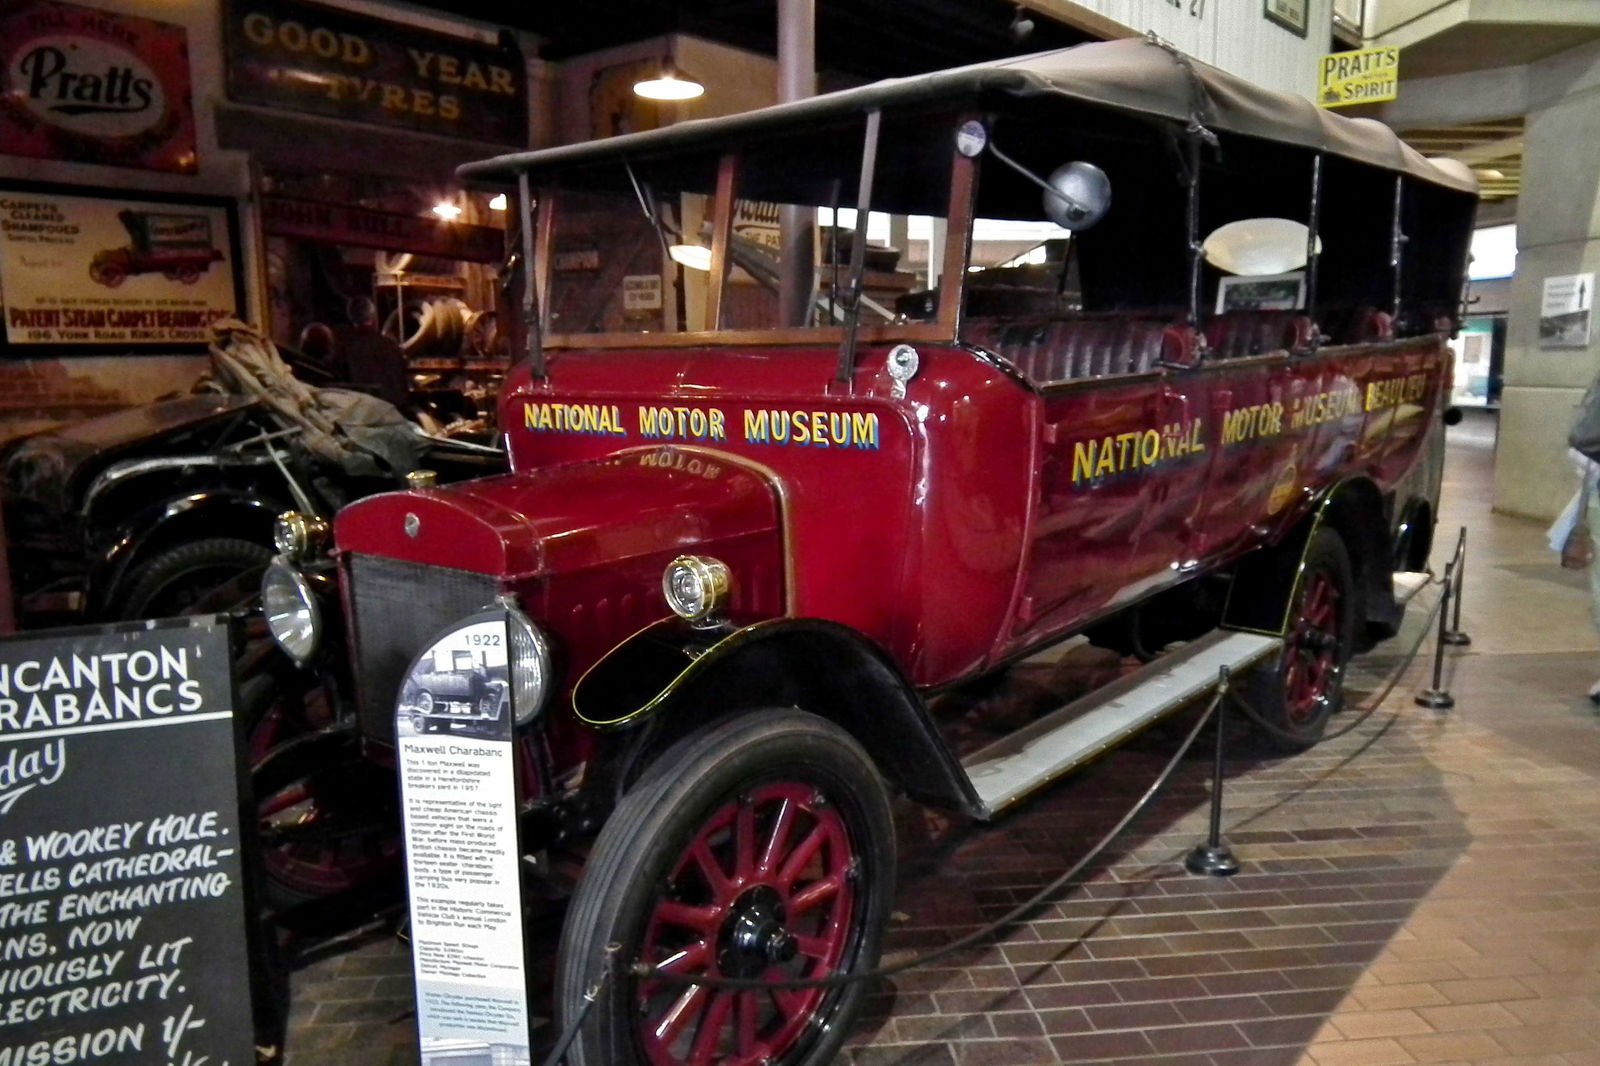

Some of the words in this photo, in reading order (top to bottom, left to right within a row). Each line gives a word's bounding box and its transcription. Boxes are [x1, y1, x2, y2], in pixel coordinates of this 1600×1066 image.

[243, 12, 371, 66] GOOD
[407, 46, 516, 97] YEAR
[1324, 47, 1397, 86] PRATTS
[20, 46, 152, 114] Pratts
[325, 73, 462, 122] TYRES
[1344, 80, 1395, 100] SPIRIT
[9, 307, 60, 328] PATENT
[63, 308, 106, 329] STEAM
[107, 308, 155, 329] CARPET
[523, 402, 626, 436] NATIONAL
[639, 406, 726, 441] MOTOR
[744, 409, 880, 449] MUSEUM
[1072, 418, 1205, 483] NATIONAL
[1221, 402, 1284, 444] MOTOR
[1290, 391, 1360, 430] MUSEUM
[1365, 374, 1427, 411] BEAULIEU
[465, 635, 500, 646] 1922
[405, 744, 446, 754] Maxwell
[0, 839, 17, 866] &
[26, 821, 143, 862] WOOKEY
[147, 811, 229, 846] HOLE.
[0, 900, 50, 928] THE
[58, 872, 232, 922] ENCHANTING
[68, 916, 142, 949] NOW
[139, 936, 193, 970] LIT
